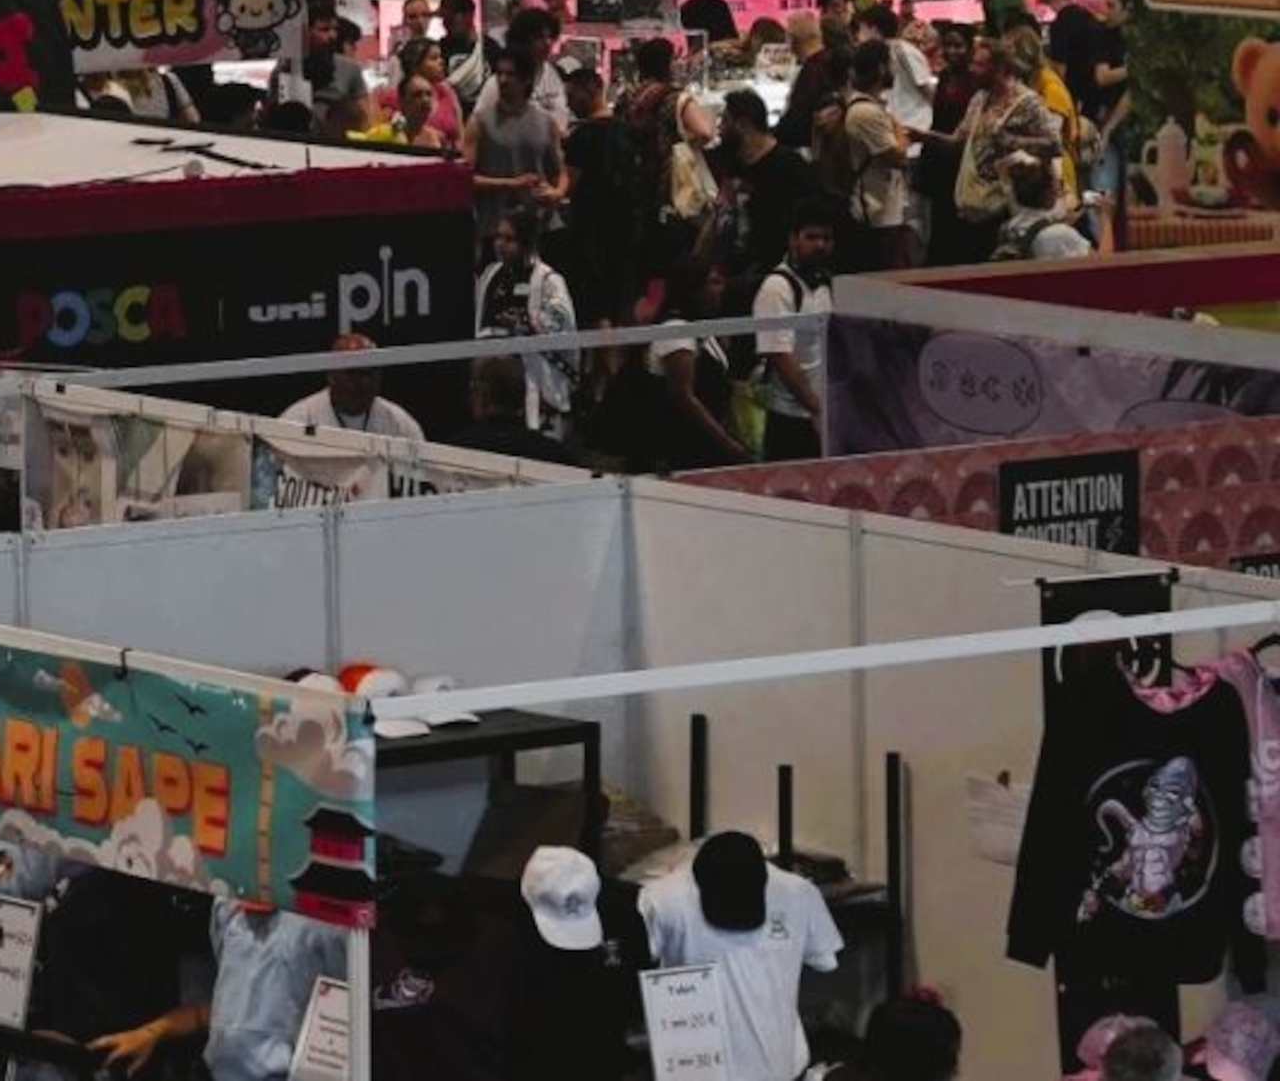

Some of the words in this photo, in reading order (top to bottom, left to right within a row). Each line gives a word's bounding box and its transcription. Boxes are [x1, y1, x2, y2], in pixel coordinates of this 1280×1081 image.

[14, 283, 188, 350] POSCA
[249, 291, 326, 323] uni
[337, 244, 431, 334] pin
[1013, 472, 1125, 521] ATTENTION
[71, 735, 231, 859] SAPE
